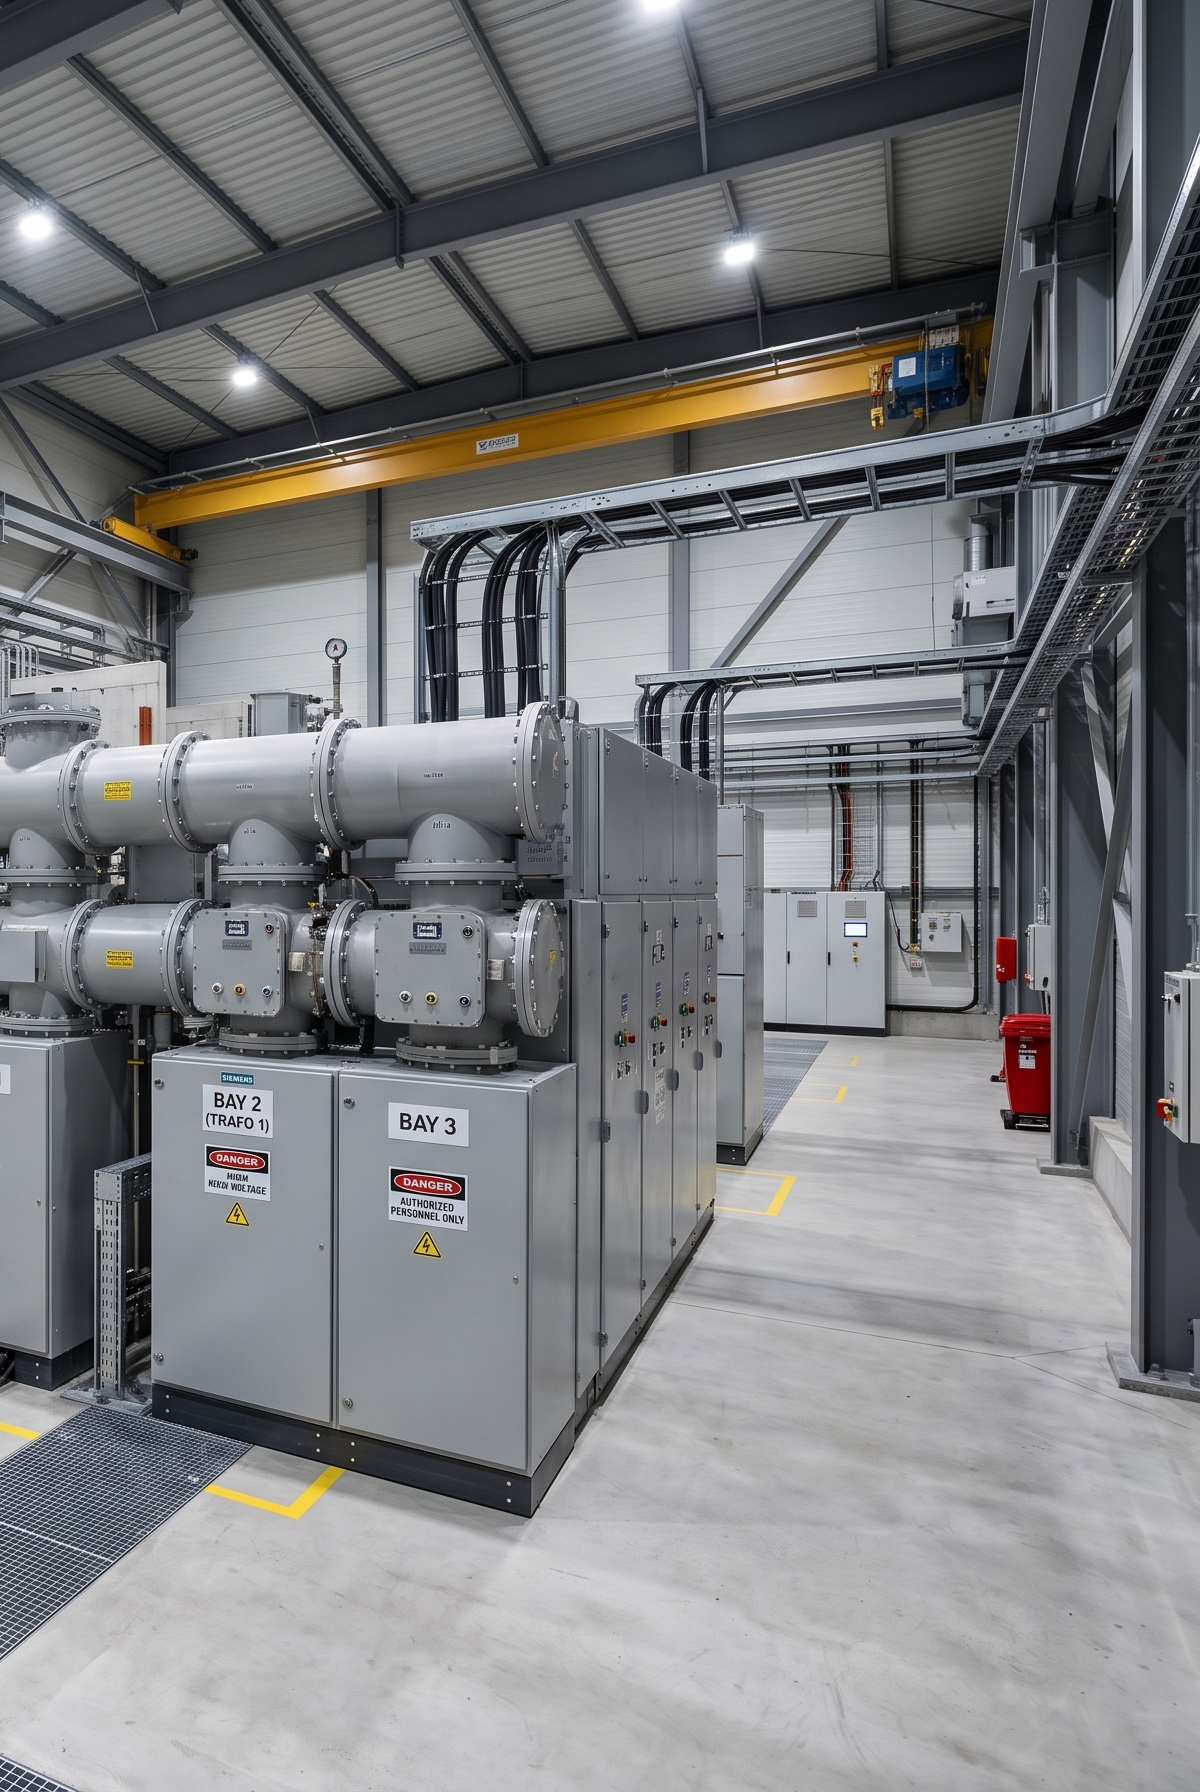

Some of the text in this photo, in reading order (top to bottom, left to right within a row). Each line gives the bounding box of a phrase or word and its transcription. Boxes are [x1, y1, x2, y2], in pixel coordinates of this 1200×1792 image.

[222, 1074, 253, 1084] SIEMENS
[214, 1091, 262, 1112] BAY 2
[205, 1112, 270, 1134] (TRAFO 1)
[399, 1112, 457, 1136] BAY 3
[216, 1153, 258, 1167] DANGER
[403, 1177, 453, 1193] DANGER
[400, 1196, 454, 1213] AUTHORIZED
[390, 1206, 465, 1225] PERSONNEL ONLY
